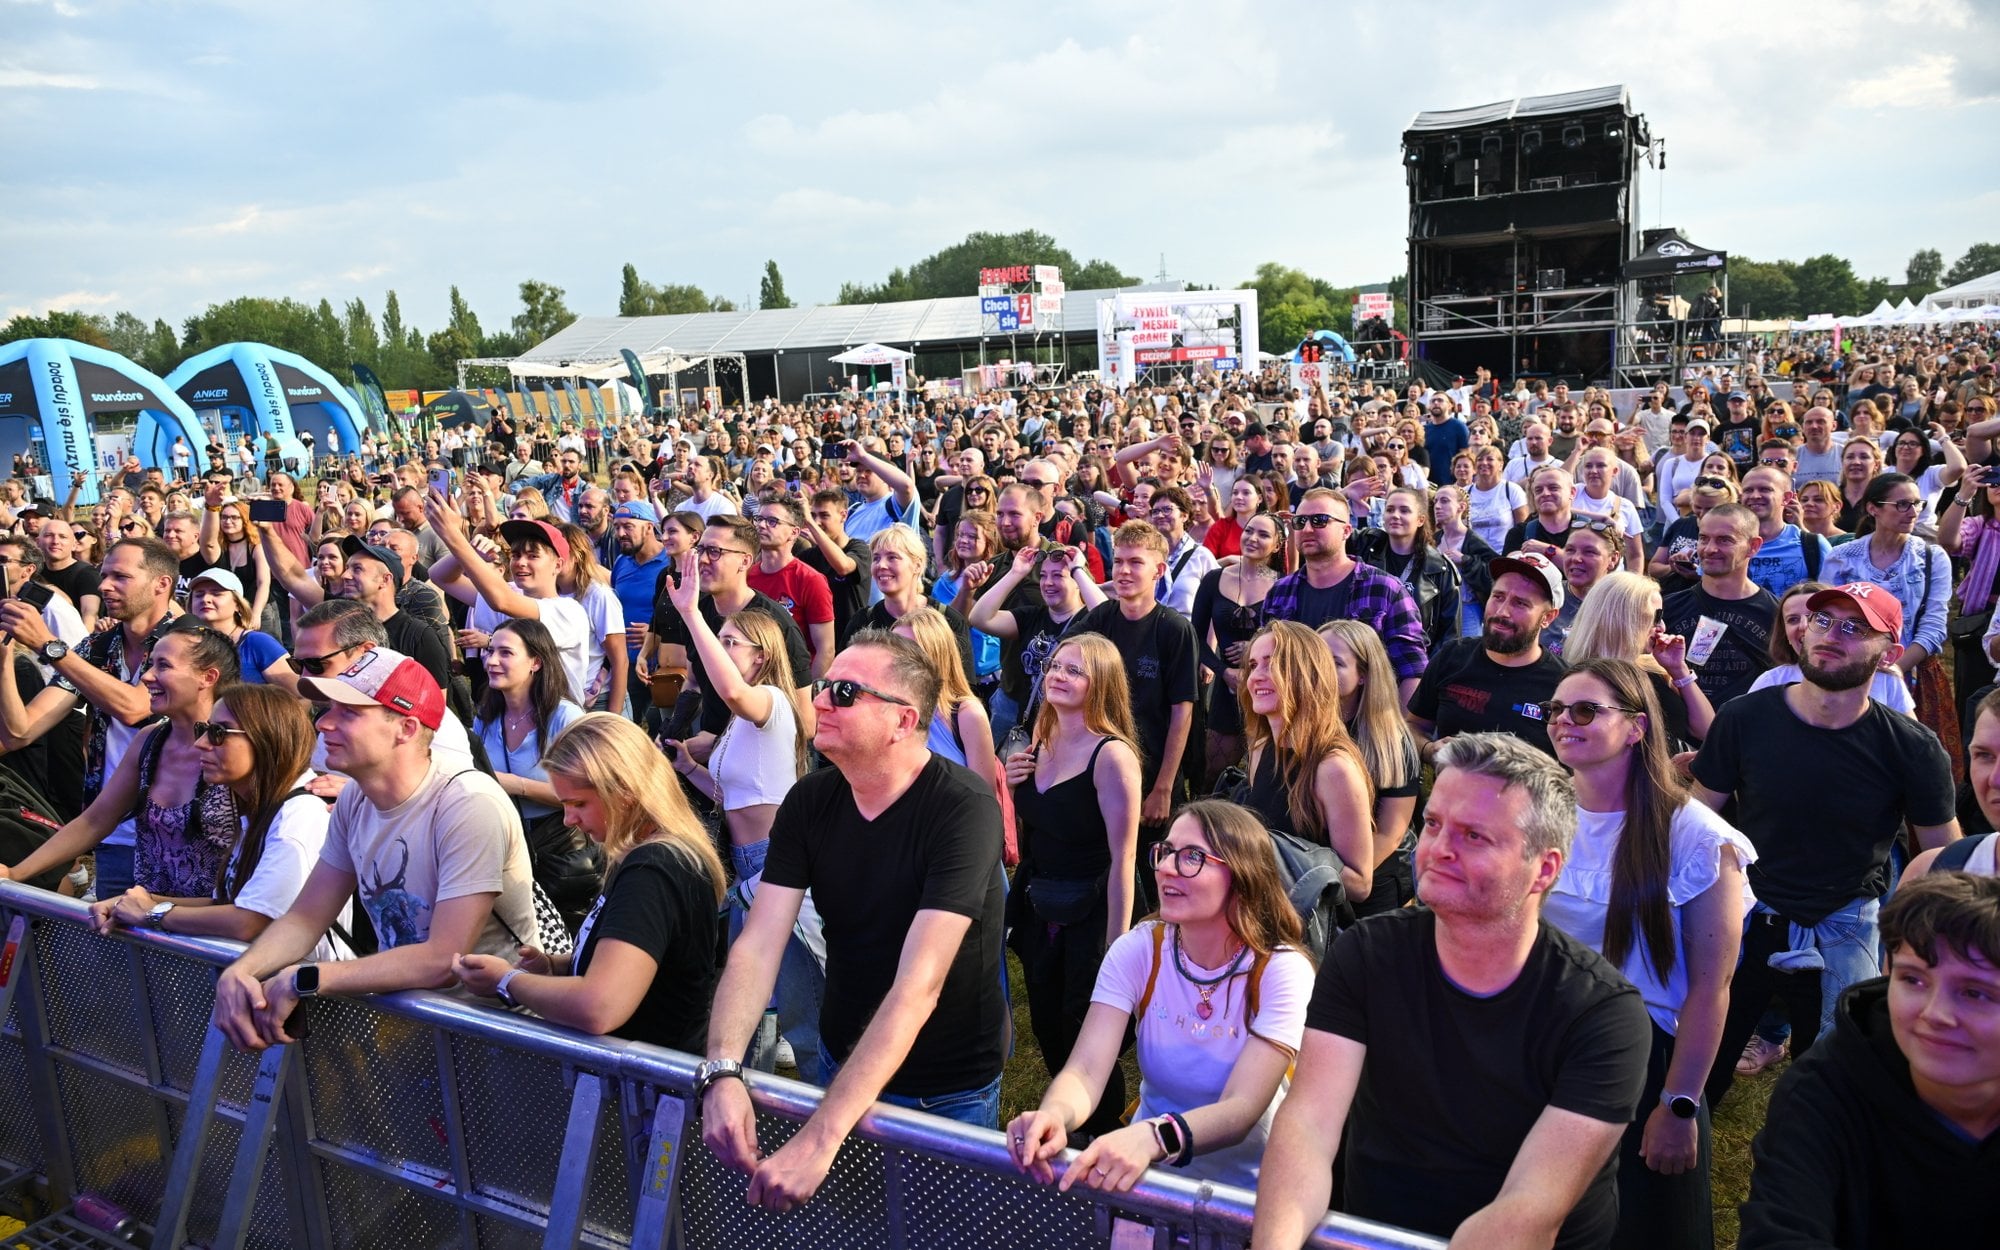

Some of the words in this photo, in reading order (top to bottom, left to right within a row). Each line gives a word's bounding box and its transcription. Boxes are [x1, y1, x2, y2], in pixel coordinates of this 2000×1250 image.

[983, 299, 1009, 312] Chce
[1020, 298, 1031, 321] Ż
[1001, 313, 1017, 328] się
[1142, 319, 1179, 332] MĘSKIE
[1132, 332, 1169, 345] GRANIE
[1216, 359, 1235, 369] 2025
[91, 390, 144, 402] soundcore
[193, 388, 229, 399] ANKER
[287, 385, 322, 396] soundcore
[57, 406, 75, 427] się
[1674, 611, 1744, 633] SEAING
